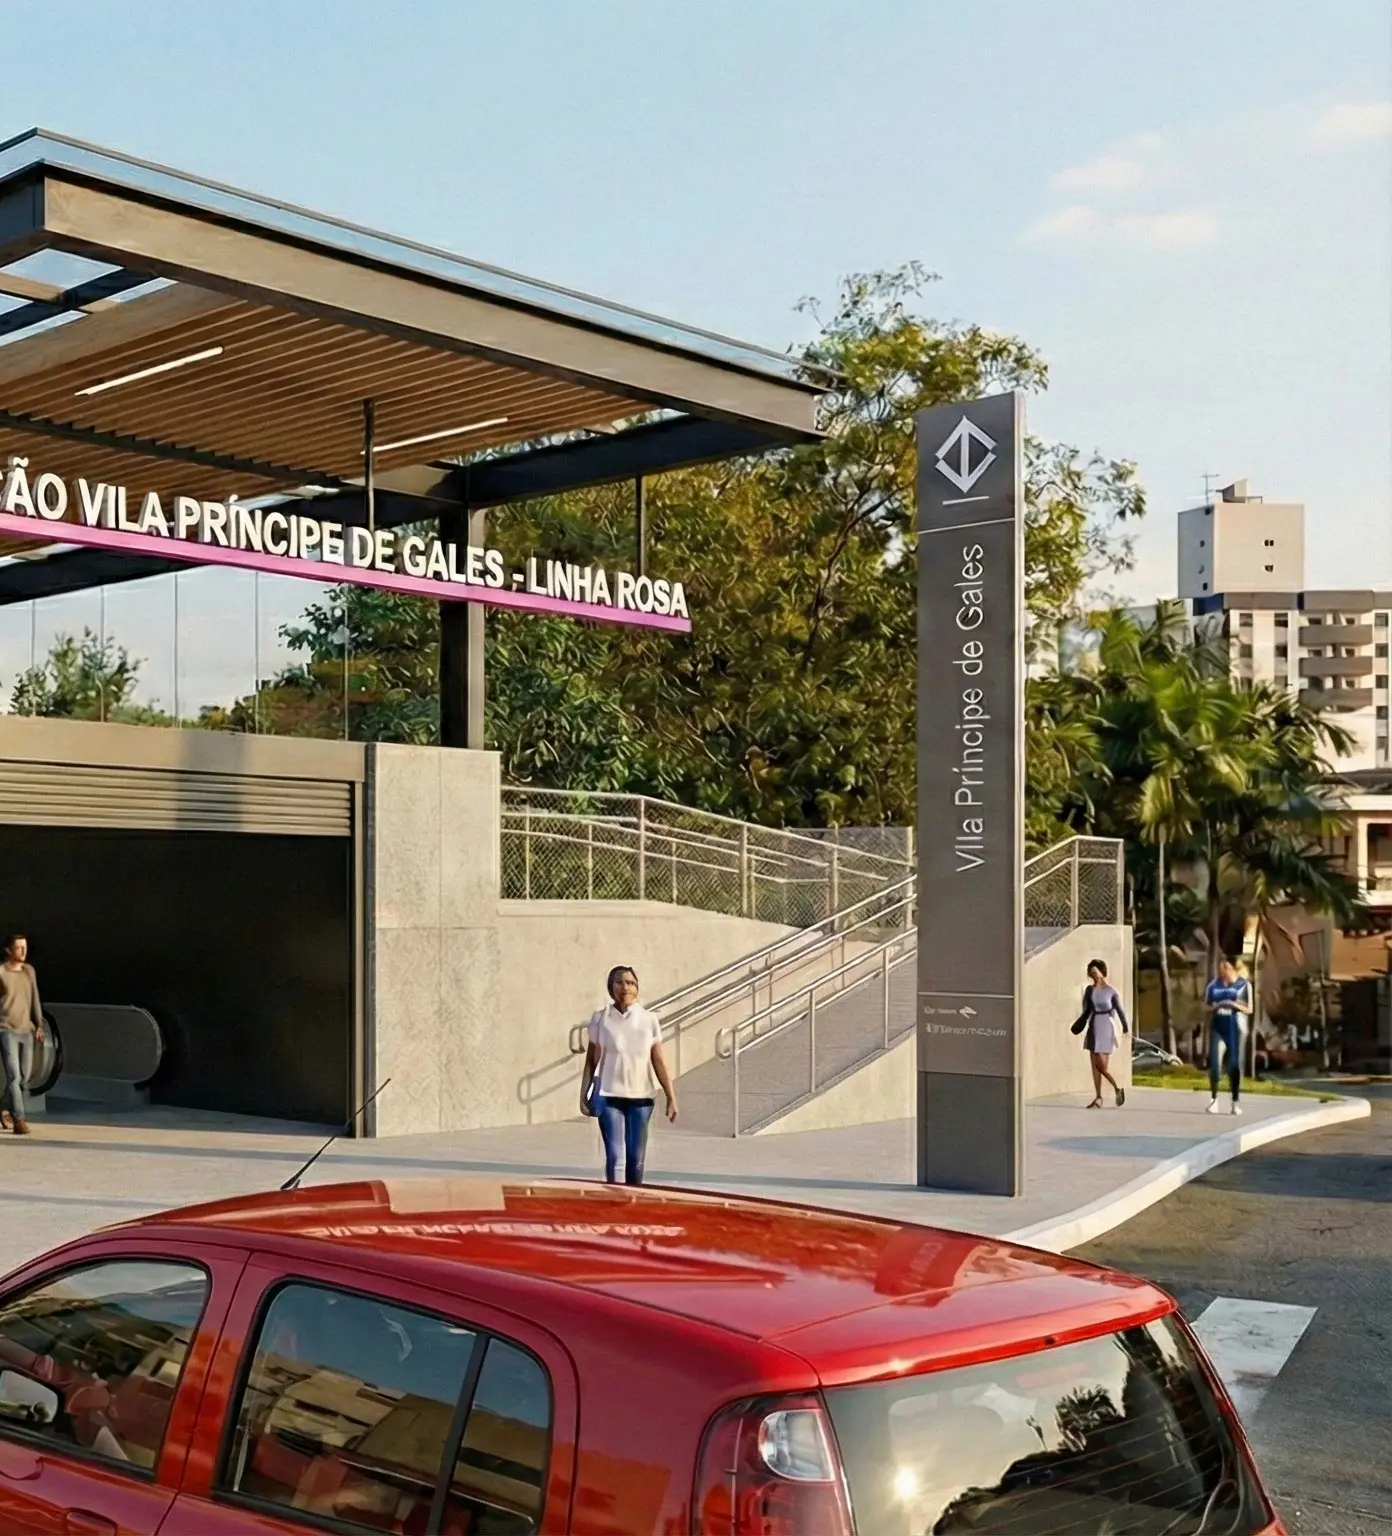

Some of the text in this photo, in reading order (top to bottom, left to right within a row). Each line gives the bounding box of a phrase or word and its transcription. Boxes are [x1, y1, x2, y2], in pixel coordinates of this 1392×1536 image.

[75, 478, 170, 538] VILA
[174, 494, 345, 566] PRÍNCIPE
[349, 526, 396, 573] DE
[402, 535, 505, 589] GALES
[527, 556, 613, 607] LINHA
[616, 571, 690, 619] ROSA
[954, 544, 985, 631] Gales
[953, 640, 984, 676] de
[952, 688, 991, 807] Príncipe
